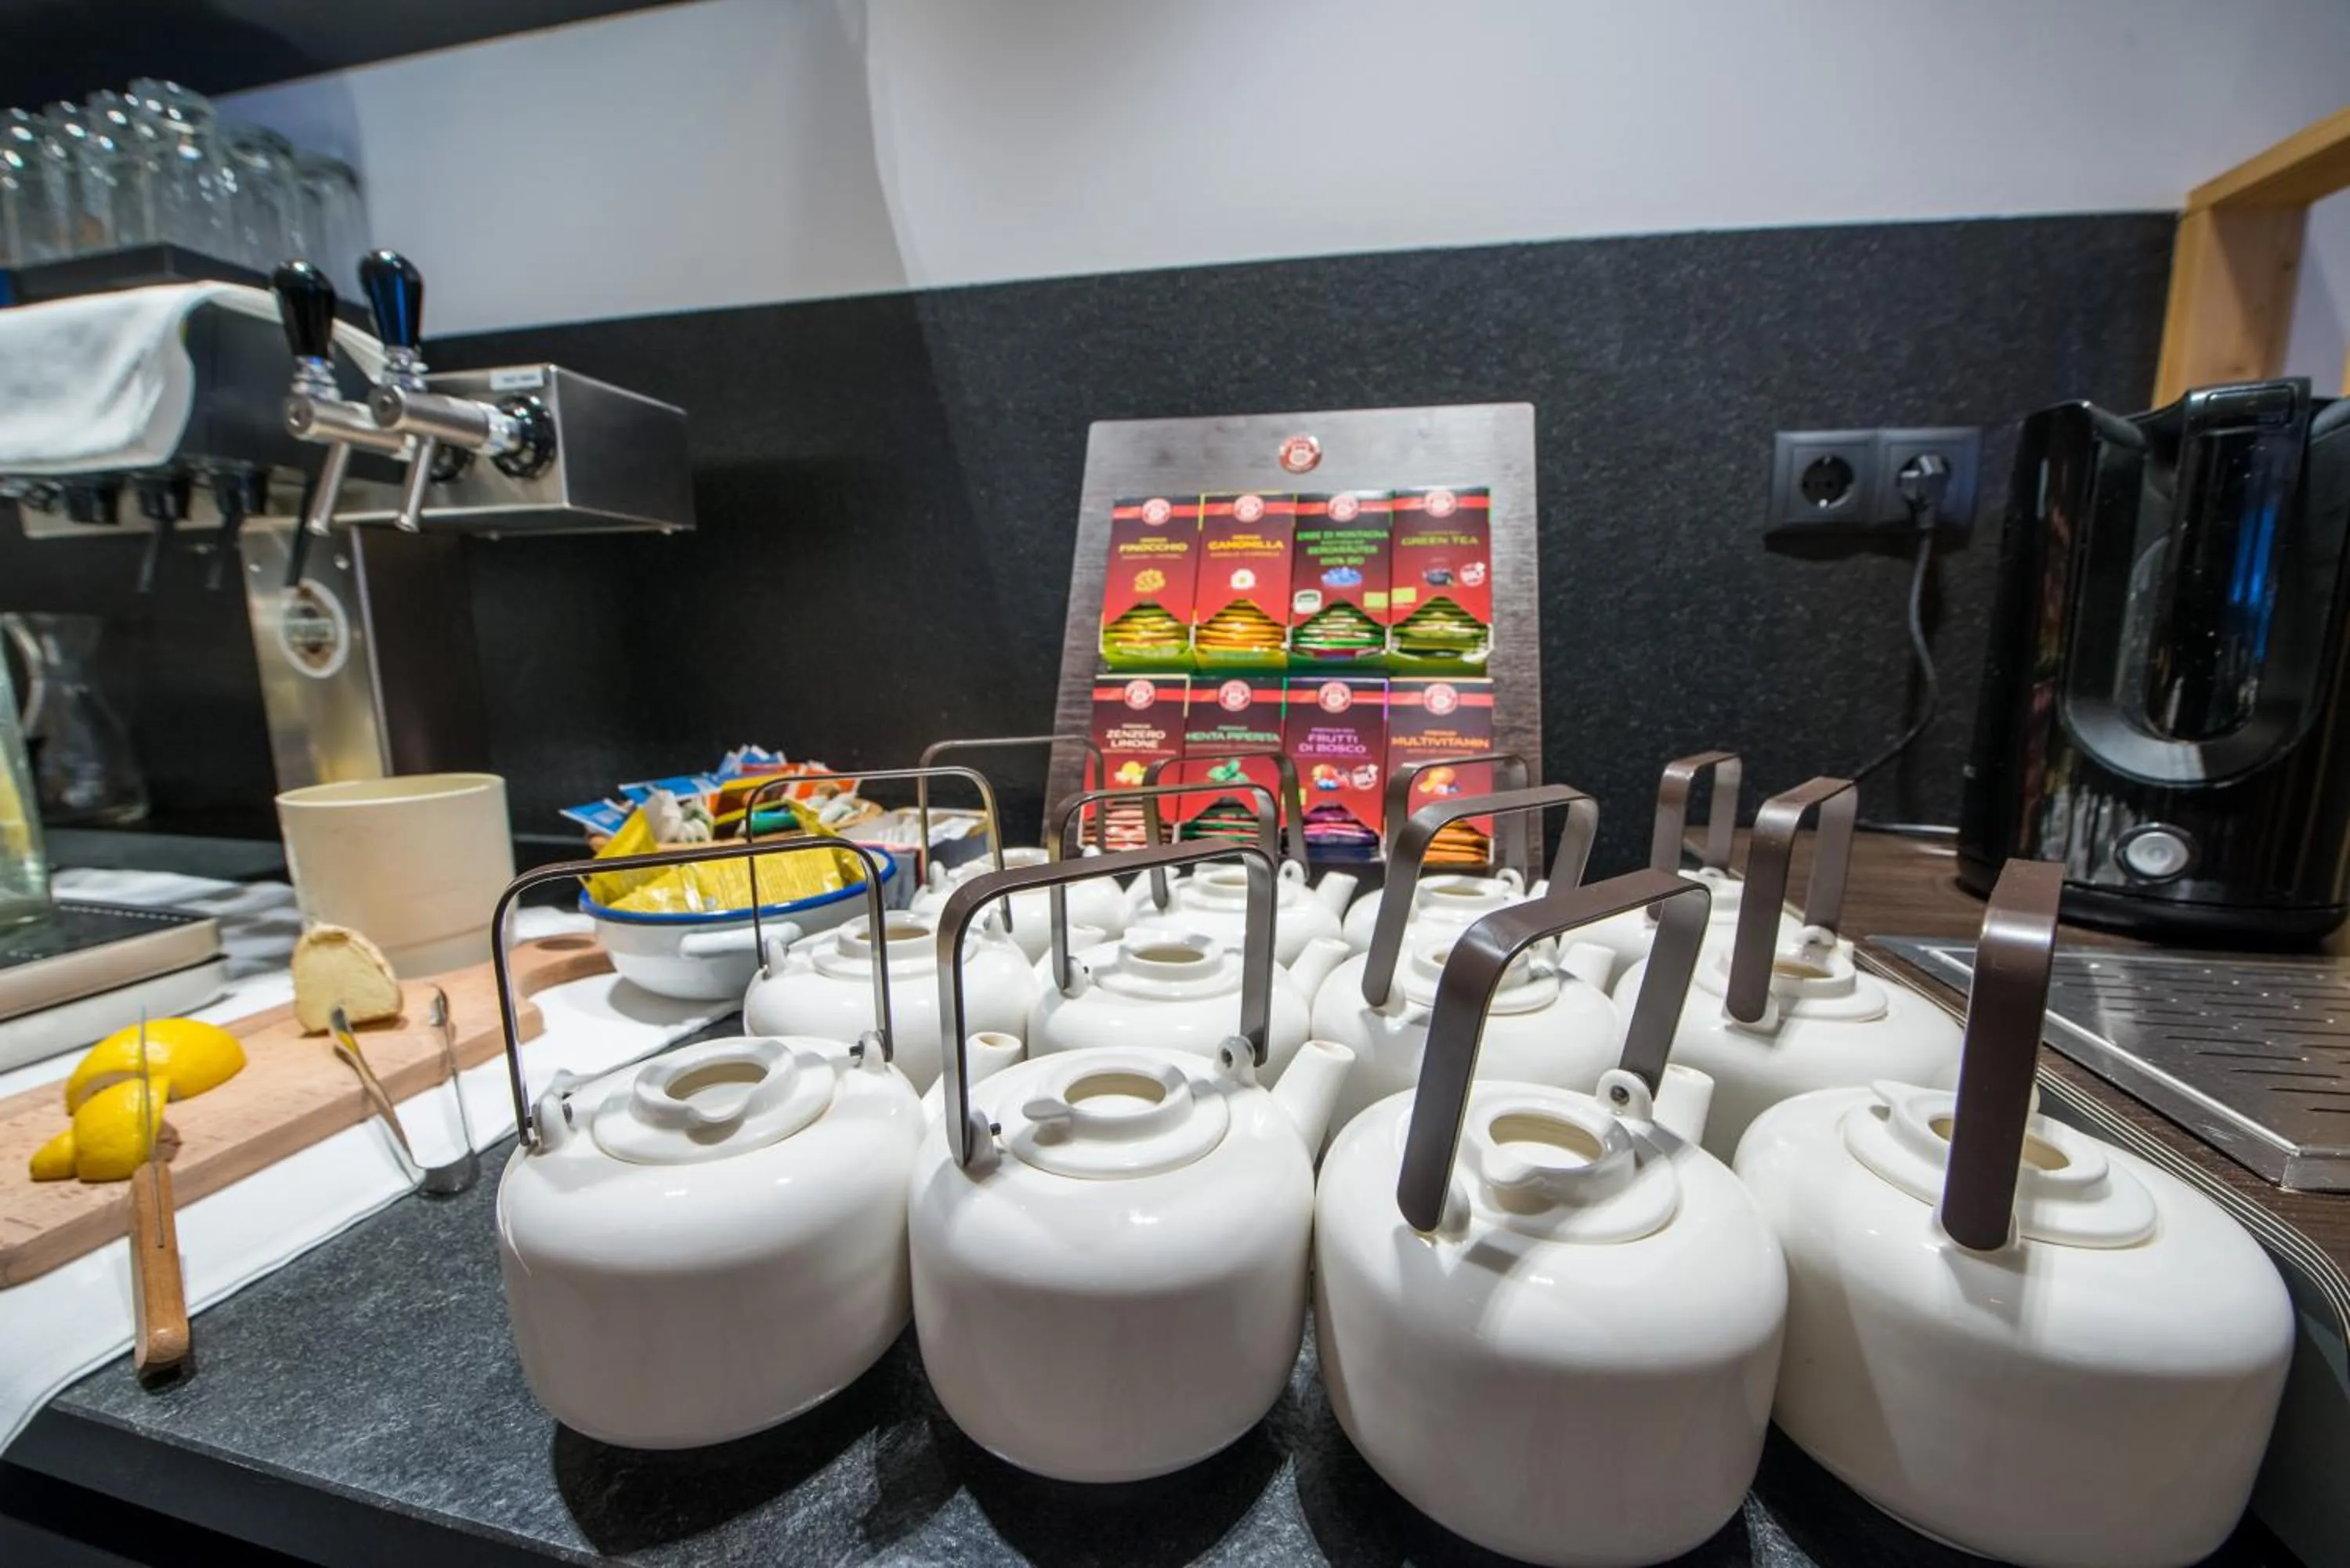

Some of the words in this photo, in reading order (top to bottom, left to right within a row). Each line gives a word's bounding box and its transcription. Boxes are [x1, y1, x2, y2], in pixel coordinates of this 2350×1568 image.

[1452, 535, 1479, 544] TEA
[1105, 729, 1166, 739] ZENZERO
[1307, 733, 1358, 743] FRUTTI
[1110, 739, 1159, 749] LIMONE
[1390, 735, 1490, 749] MULTIVITAMIN
[1298, 744, 1314, 753] DI
[1315, 743, 1367, 754] BOSCO
